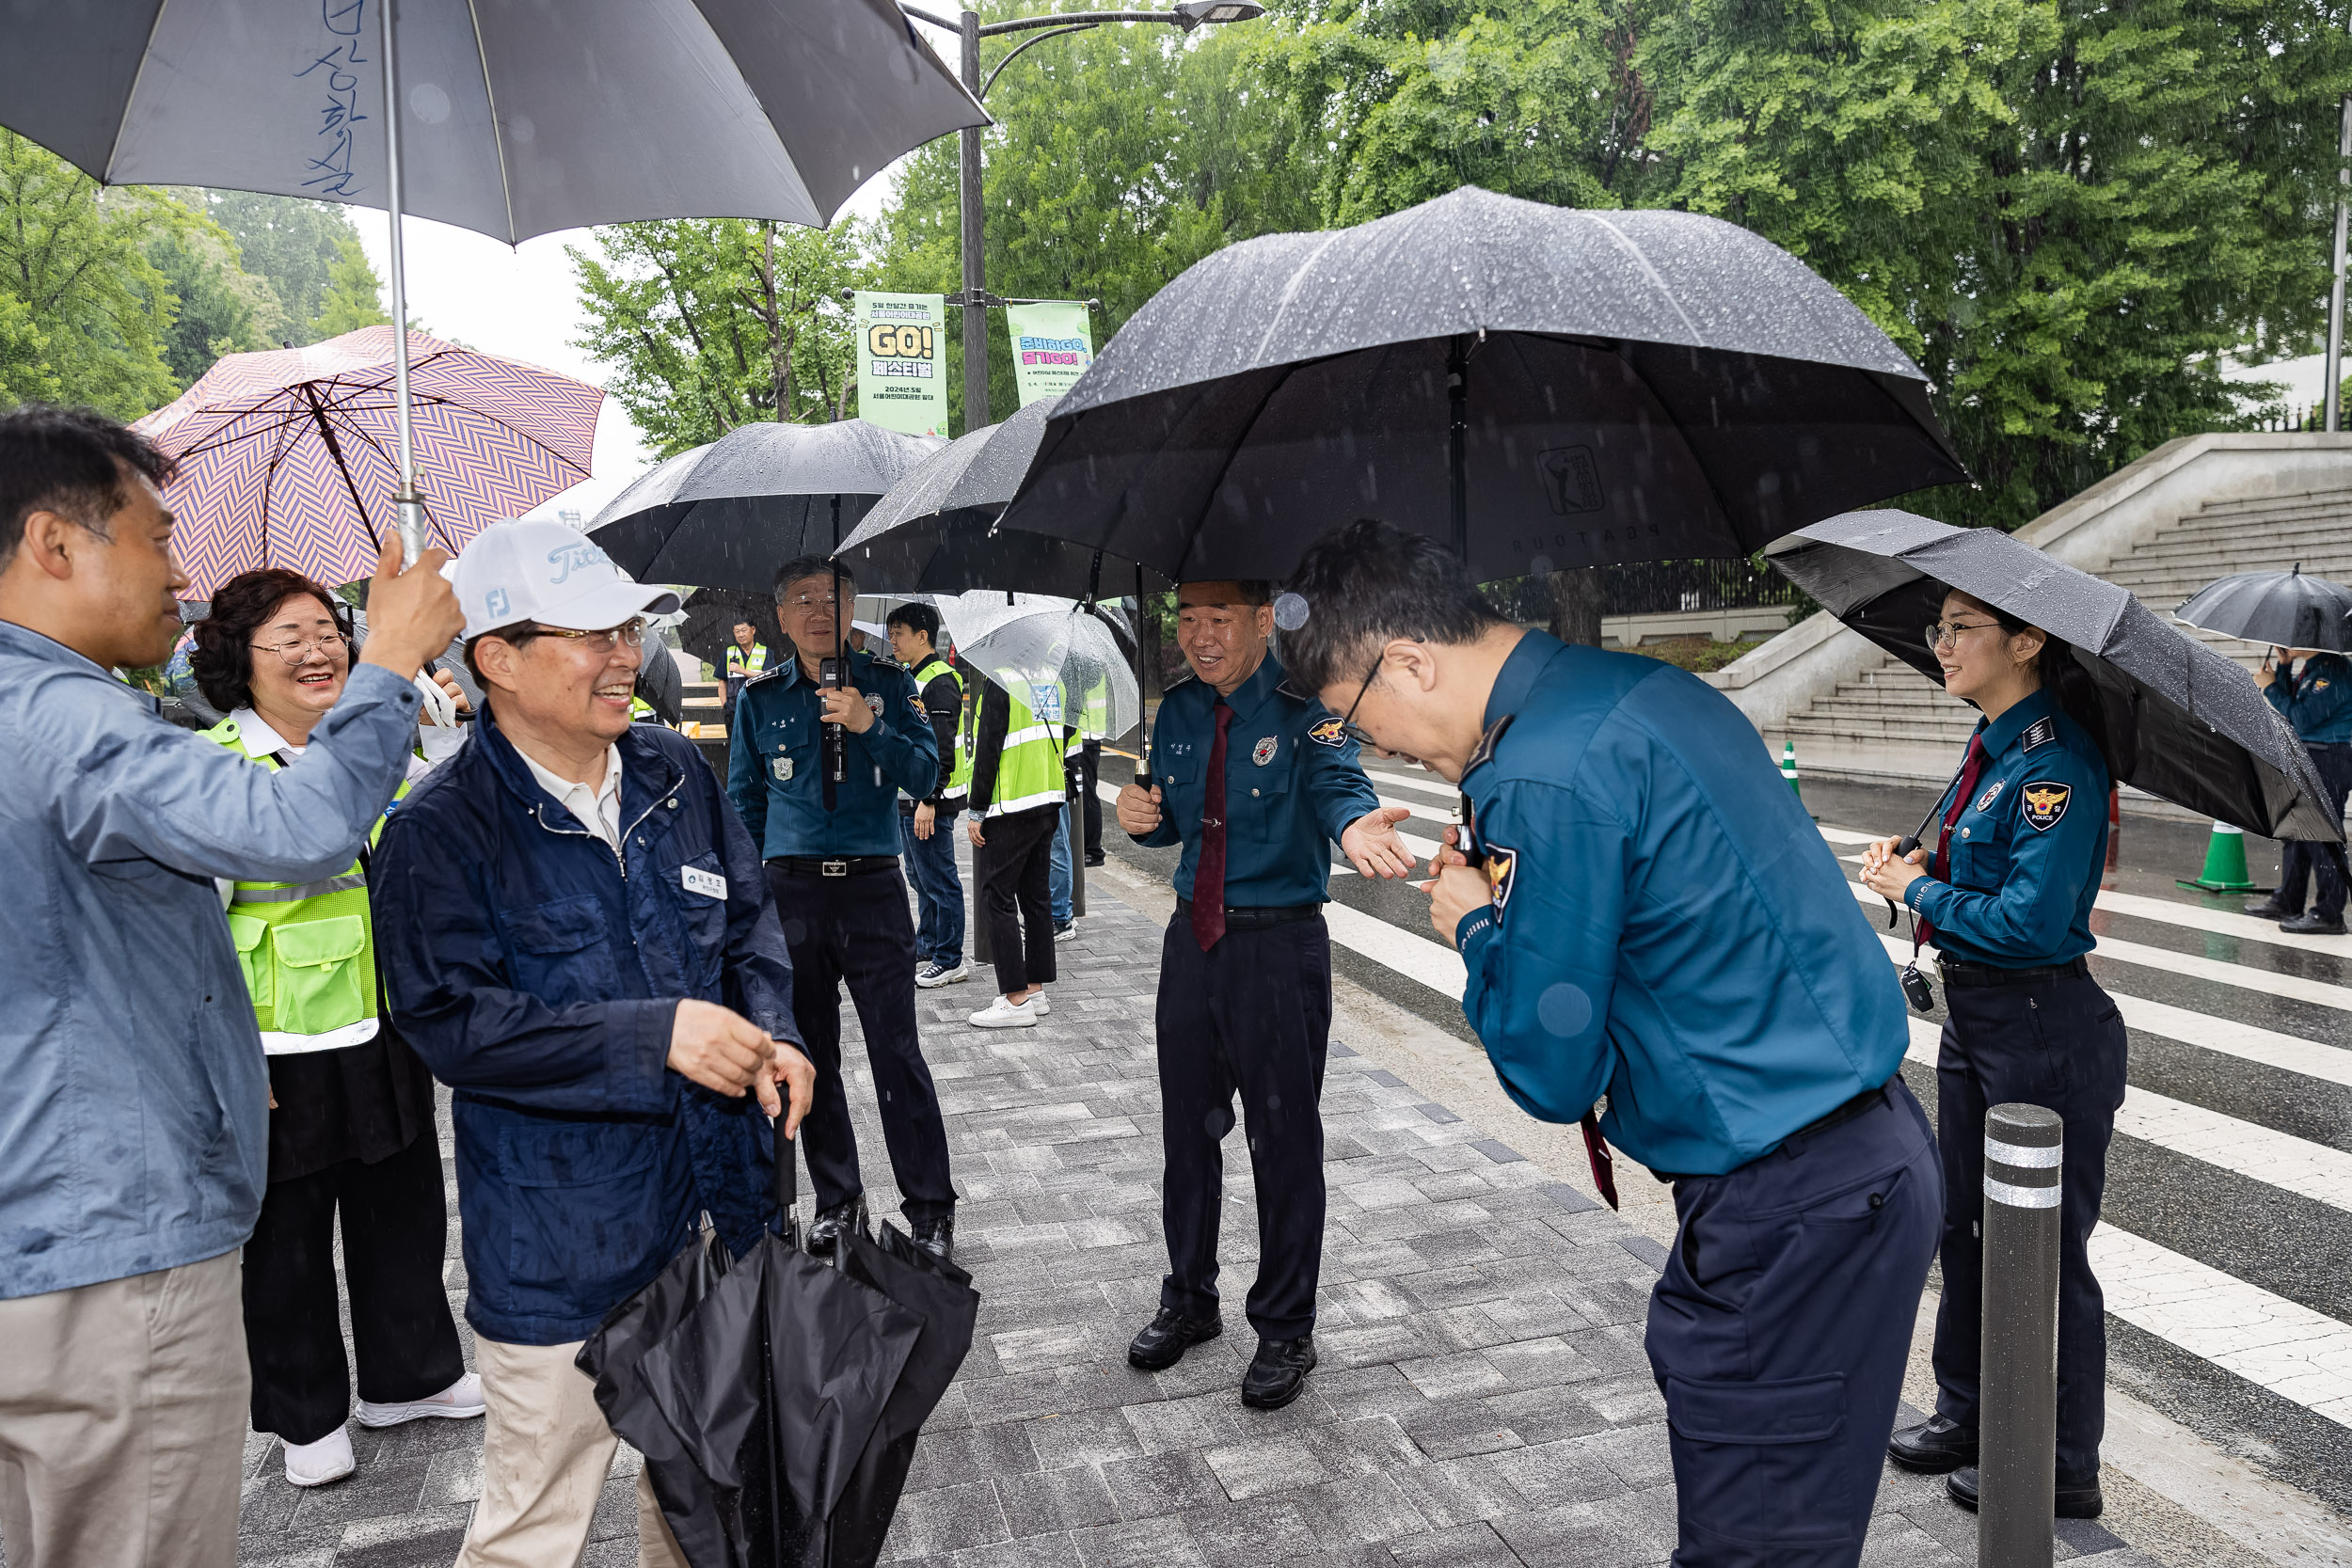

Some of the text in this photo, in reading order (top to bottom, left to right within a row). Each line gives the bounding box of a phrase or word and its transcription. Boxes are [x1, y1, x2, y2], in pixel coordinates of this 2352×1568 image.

[870, 309, 930, 320] 서울어린이대공원
[868, 325, 933, 360] GO!
[1020, 337, 1087, 353] 준비하GO,
[1022, 352, 1078, 366] 즐기GO!
[871, 360, 933, 378] 페스티벌
